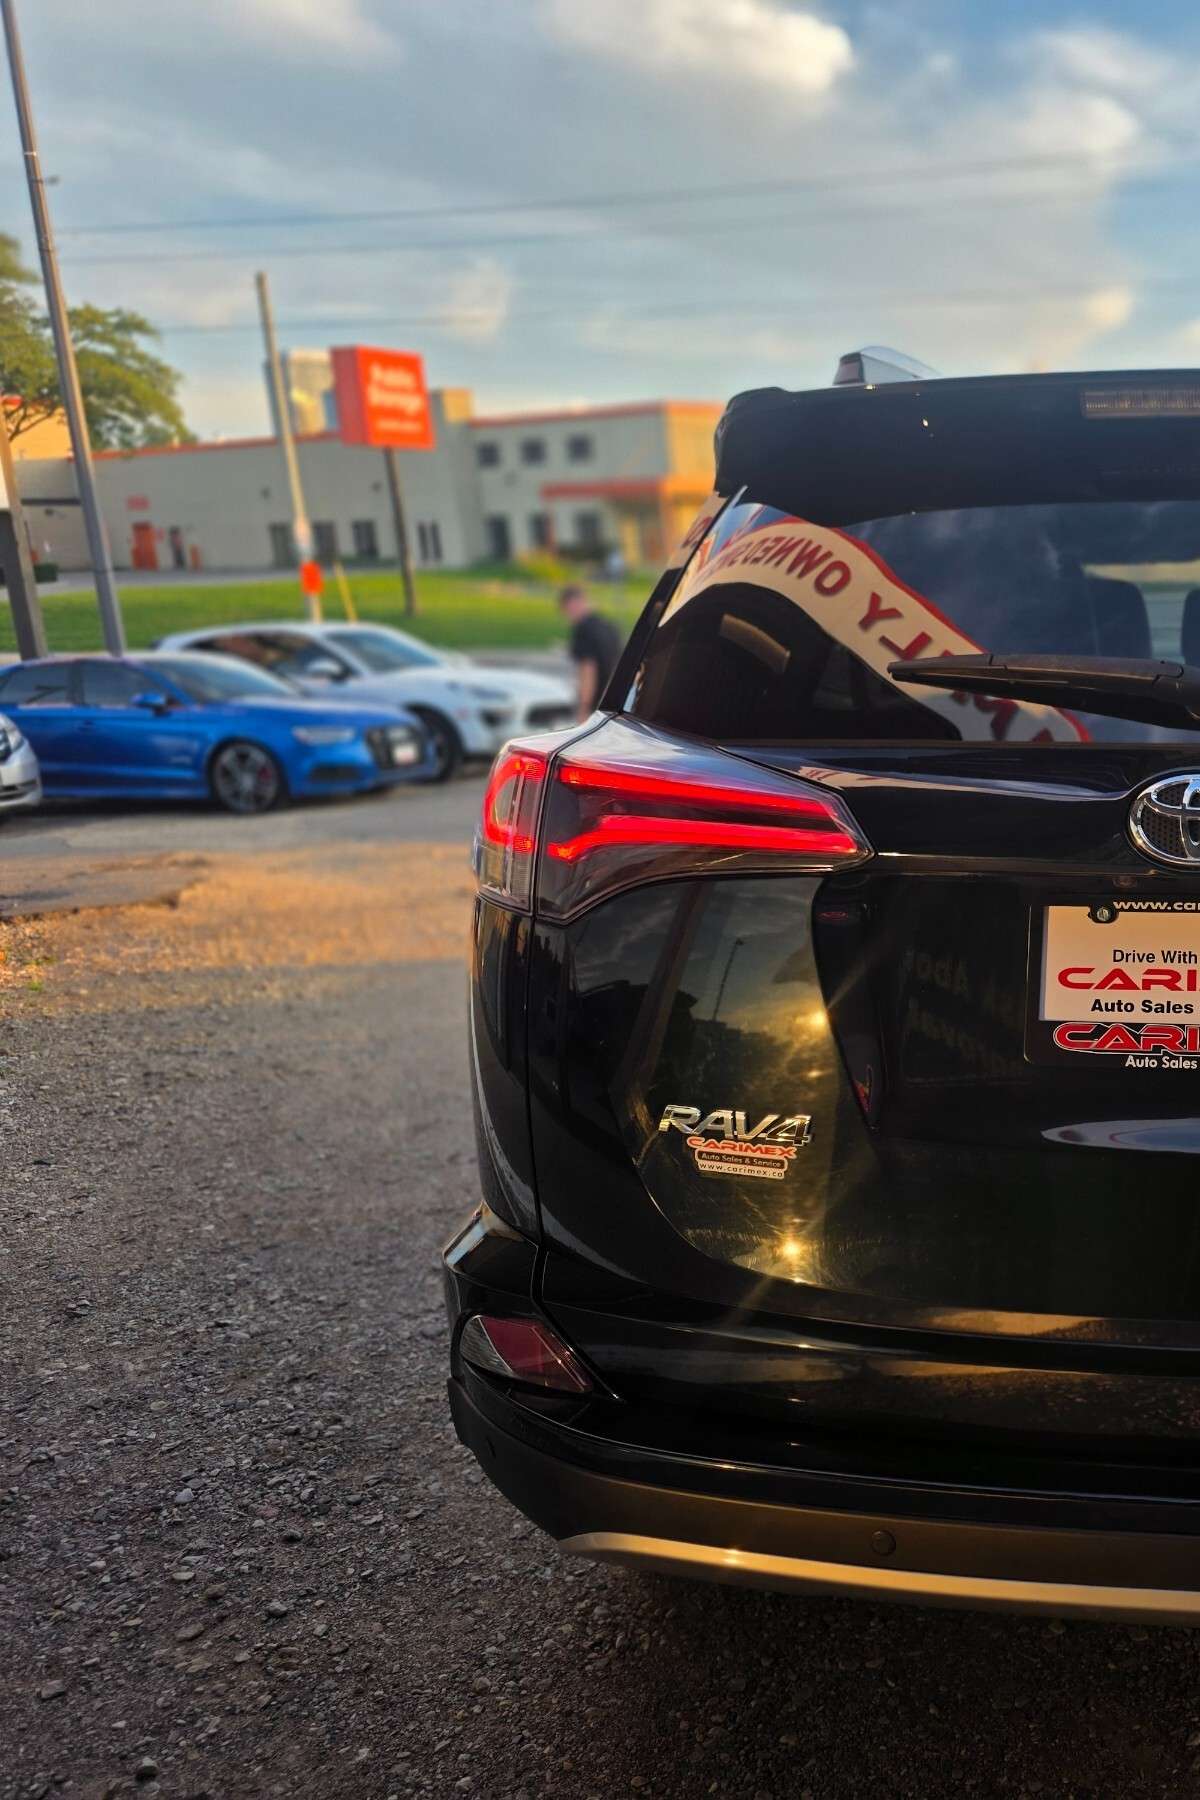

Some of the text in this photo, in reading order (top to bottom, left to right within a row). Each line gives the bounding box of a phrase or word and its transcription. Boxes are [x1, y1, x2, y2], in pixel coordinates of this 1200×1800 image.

[1112, 950, 1155, 963] Drive
[1161, 950, 1198, 964] With
[1090, 999, 1135, 1013] Auto
[1141, 1000, 1194, 1014] Sales
[1124, 1056, 1157, 1069] Auto
[1161, 1056, 1198, 1070] Sales
[658, 1104, 814, 1147] RAV4
[688, 1137, 796, 1158] CARIMEX
[701, 1152, 720, 1161] Auto
[722, 1154, 742, 1164] Sales
[753, 1158, 782, 1168] Service
